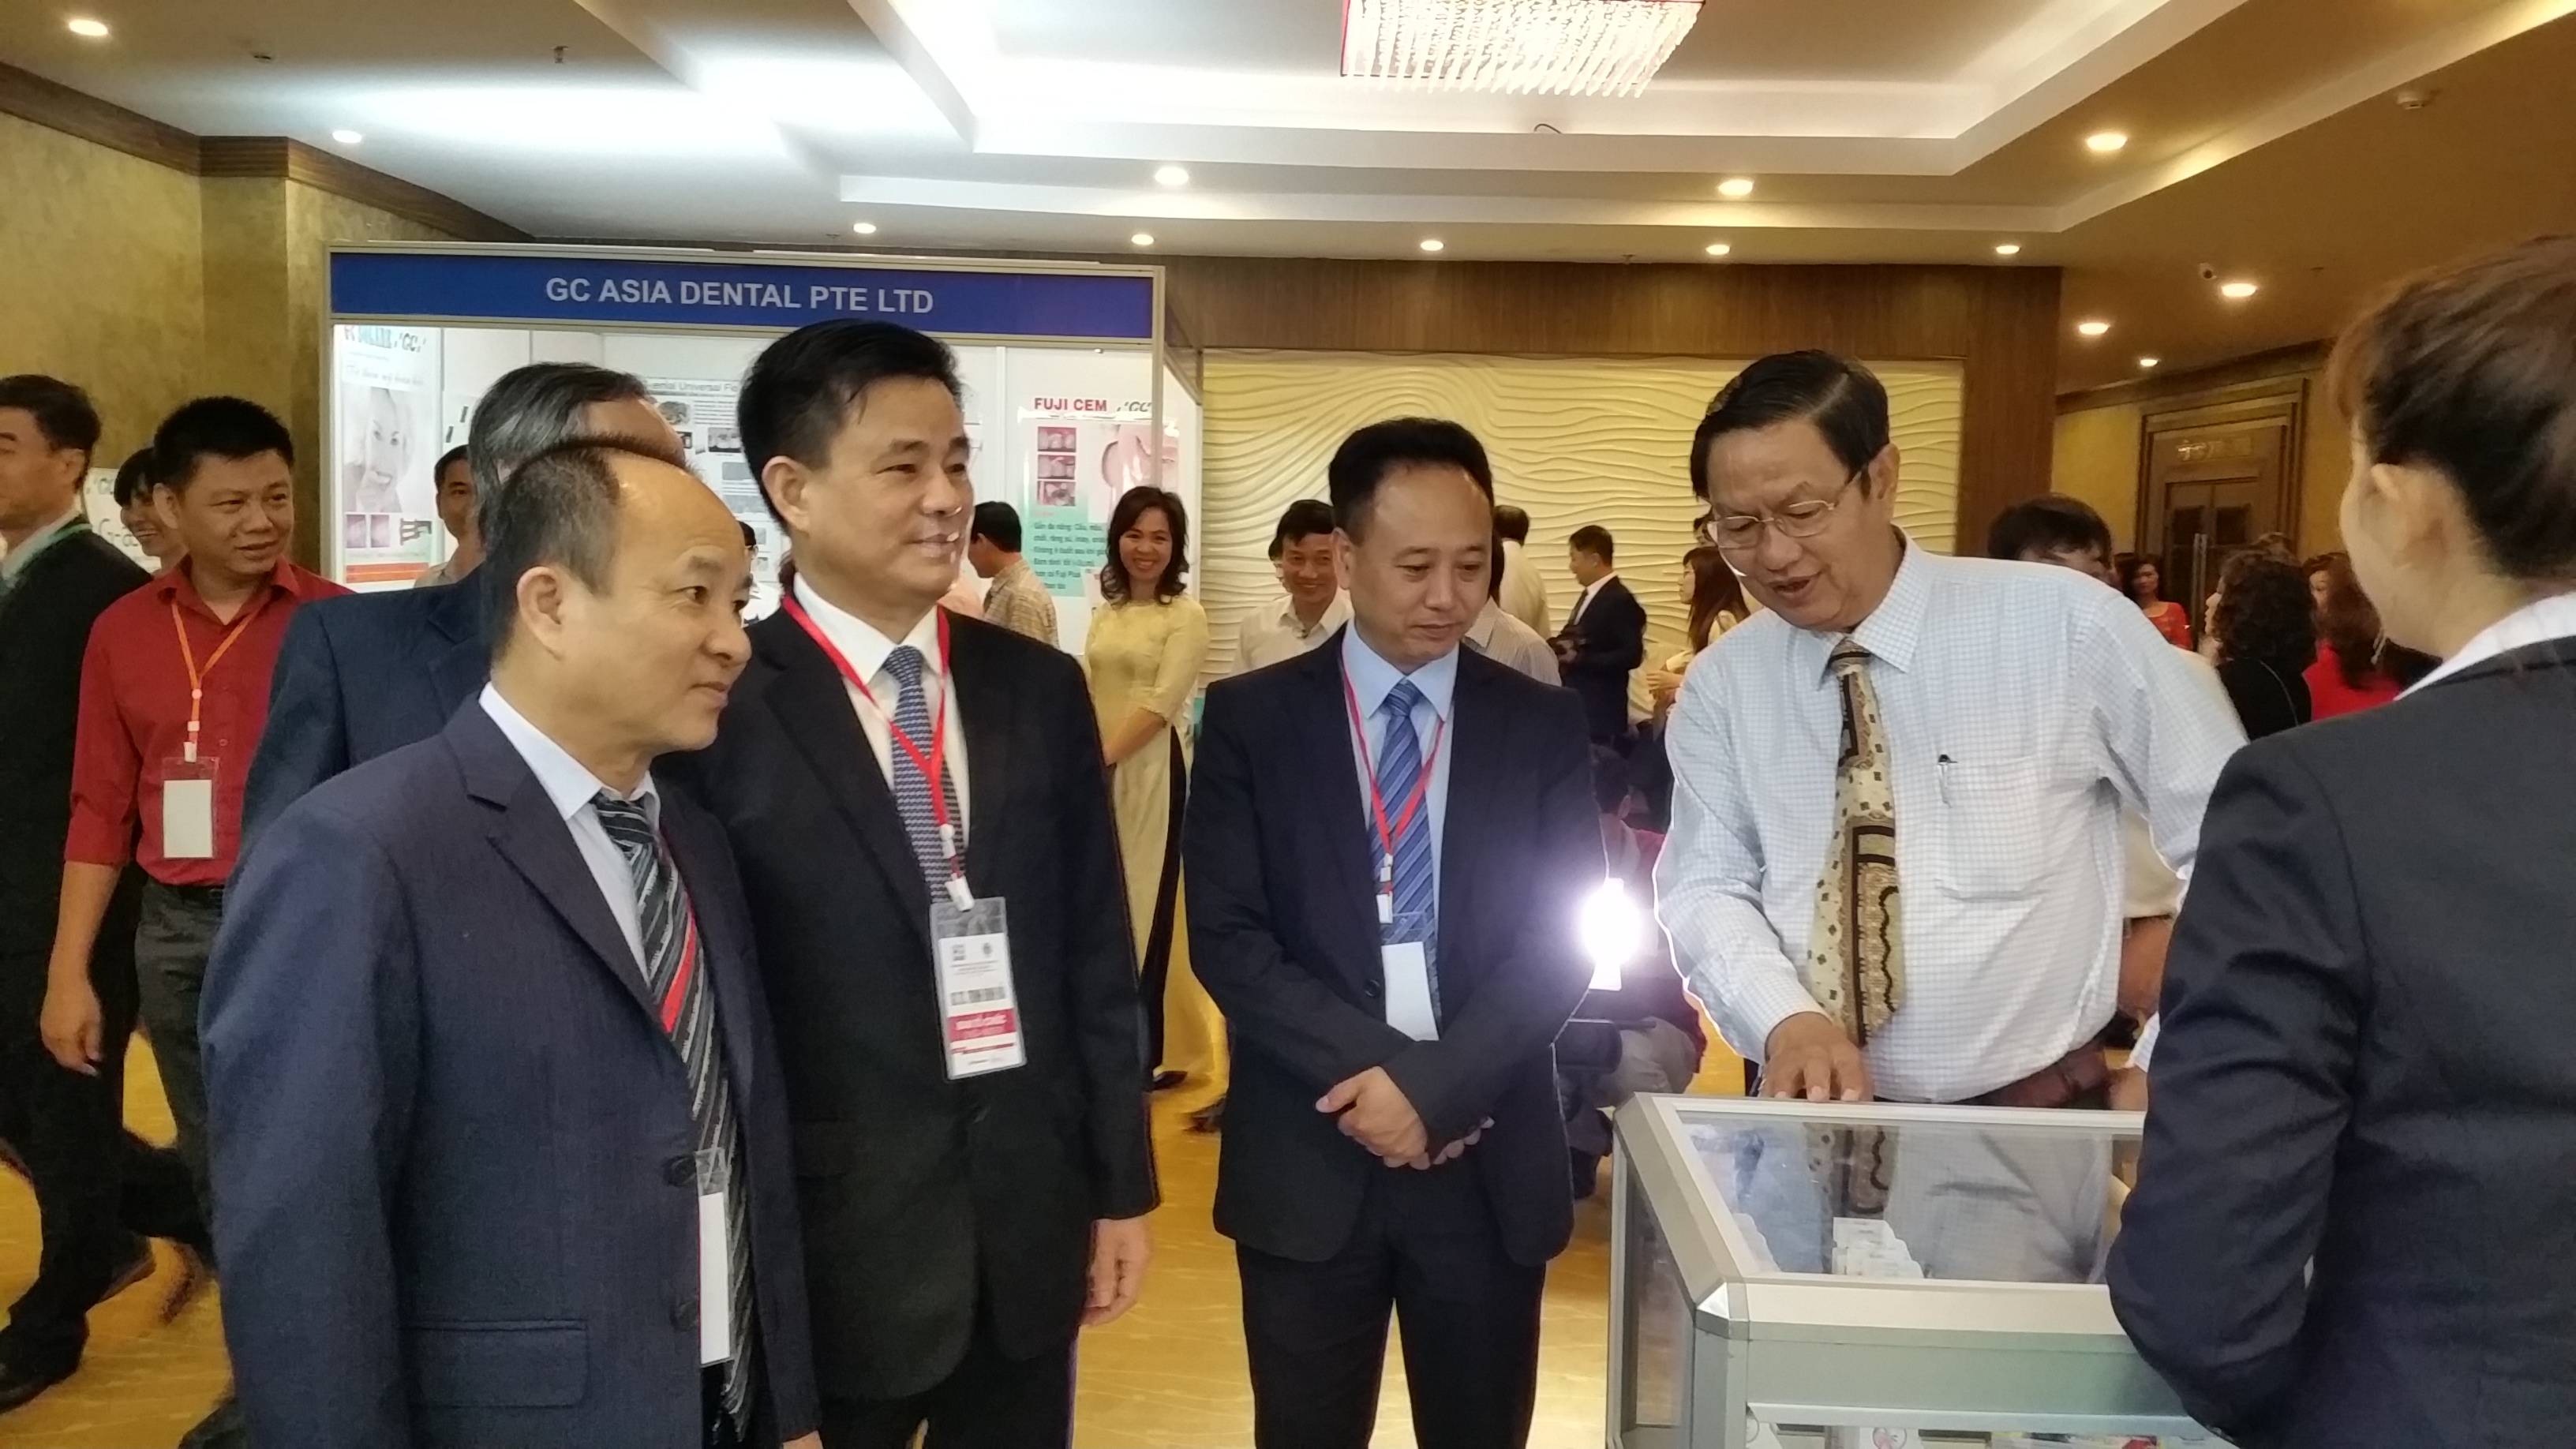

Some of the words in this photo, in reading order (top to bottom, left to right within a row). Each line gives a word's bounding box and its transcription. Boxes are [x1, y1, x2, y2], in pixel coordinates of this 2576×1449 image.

[546, 277, 590, 301] GC
[598, 279, 672, 304] ASIA
[680, 281, 802, 308] DENTAL
[811, 286, 868, 311] PTE
[878, 289, 934, 313] LTD
[1034, 397, 1068, 410] FUJI
[1073, 399, 1107, 412] CEM
